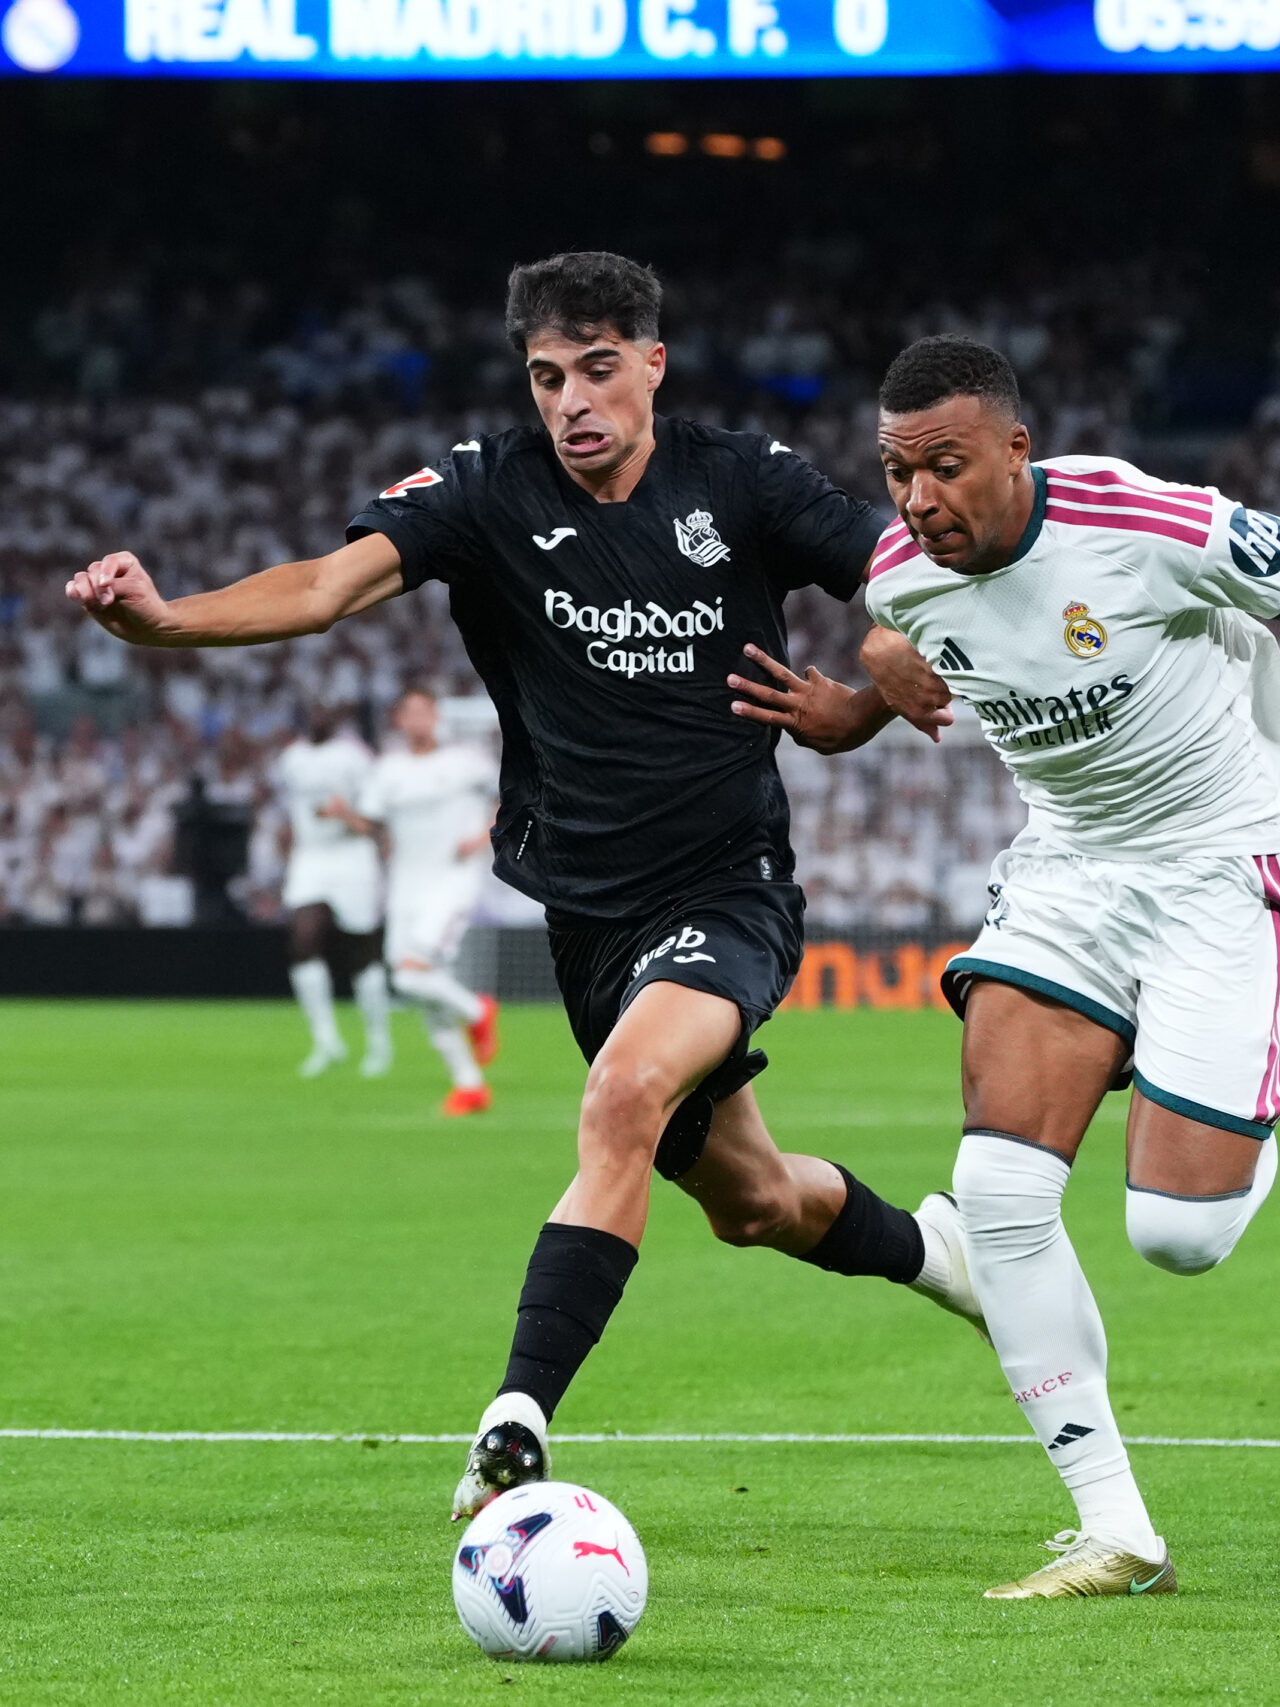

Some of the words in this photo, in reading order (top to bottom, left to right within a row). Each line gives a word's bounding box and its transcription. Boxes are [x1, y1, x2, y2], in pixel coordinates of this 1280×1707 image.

[124, 0, 317, 61] REAL
[328, 0, 627, 59] MADRID
[543, 588, 725, 643] Baghdadi
[586, 643, 695, 680] Capital
[977, 673, 1135, 726] mirates
[631, 926, 707, 979] web
[1013, 1371, 1073, 1404] RMCF
